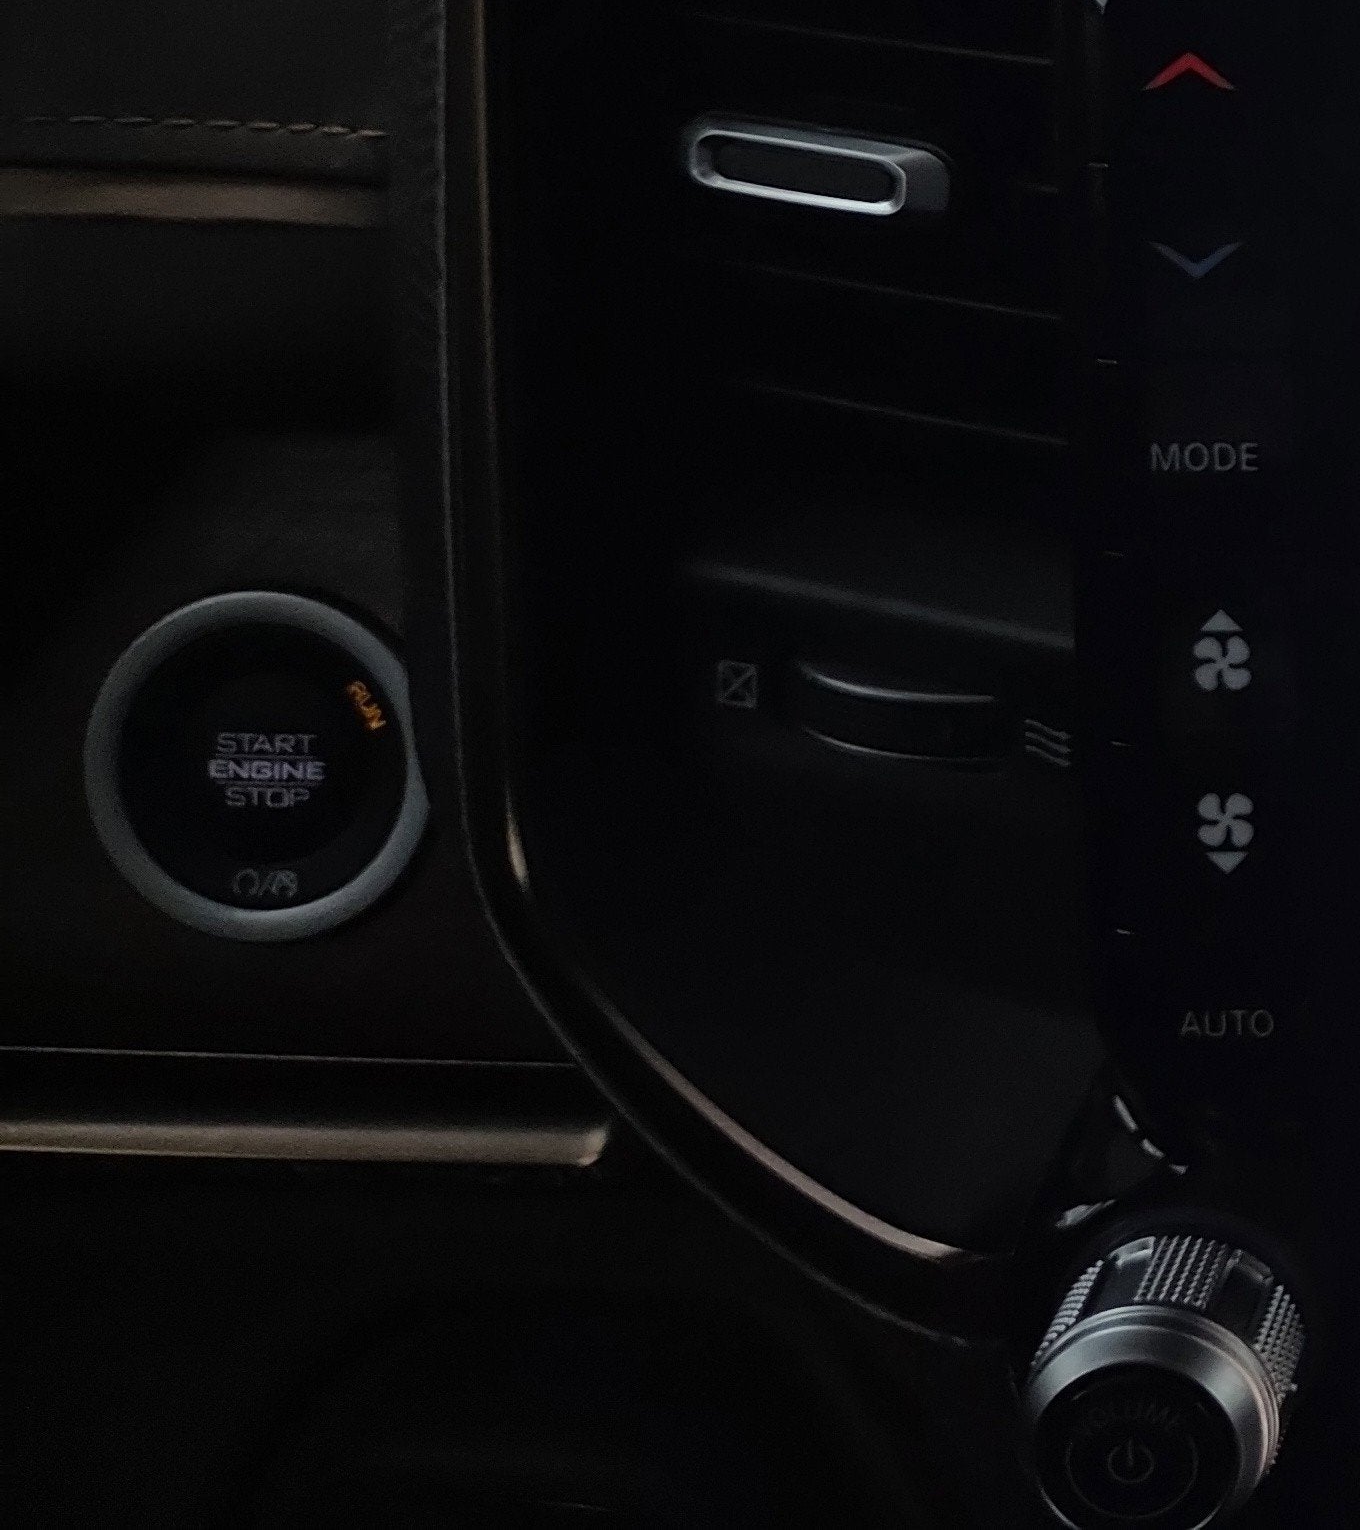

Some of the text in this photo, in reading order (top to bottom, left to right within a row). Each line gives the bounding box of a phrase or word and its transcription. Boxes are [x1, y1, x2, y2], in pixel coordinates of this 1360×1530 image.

[1150, 441, 1260, 472] MODE
[346, 680, 387, 730] RUN
[216, 733, 318, 754] START
[208, 759, 326, 780] ENGINE
[225, 786, 310, 808] STOP
[1179, 1008, 1275, 1038] AUTO
